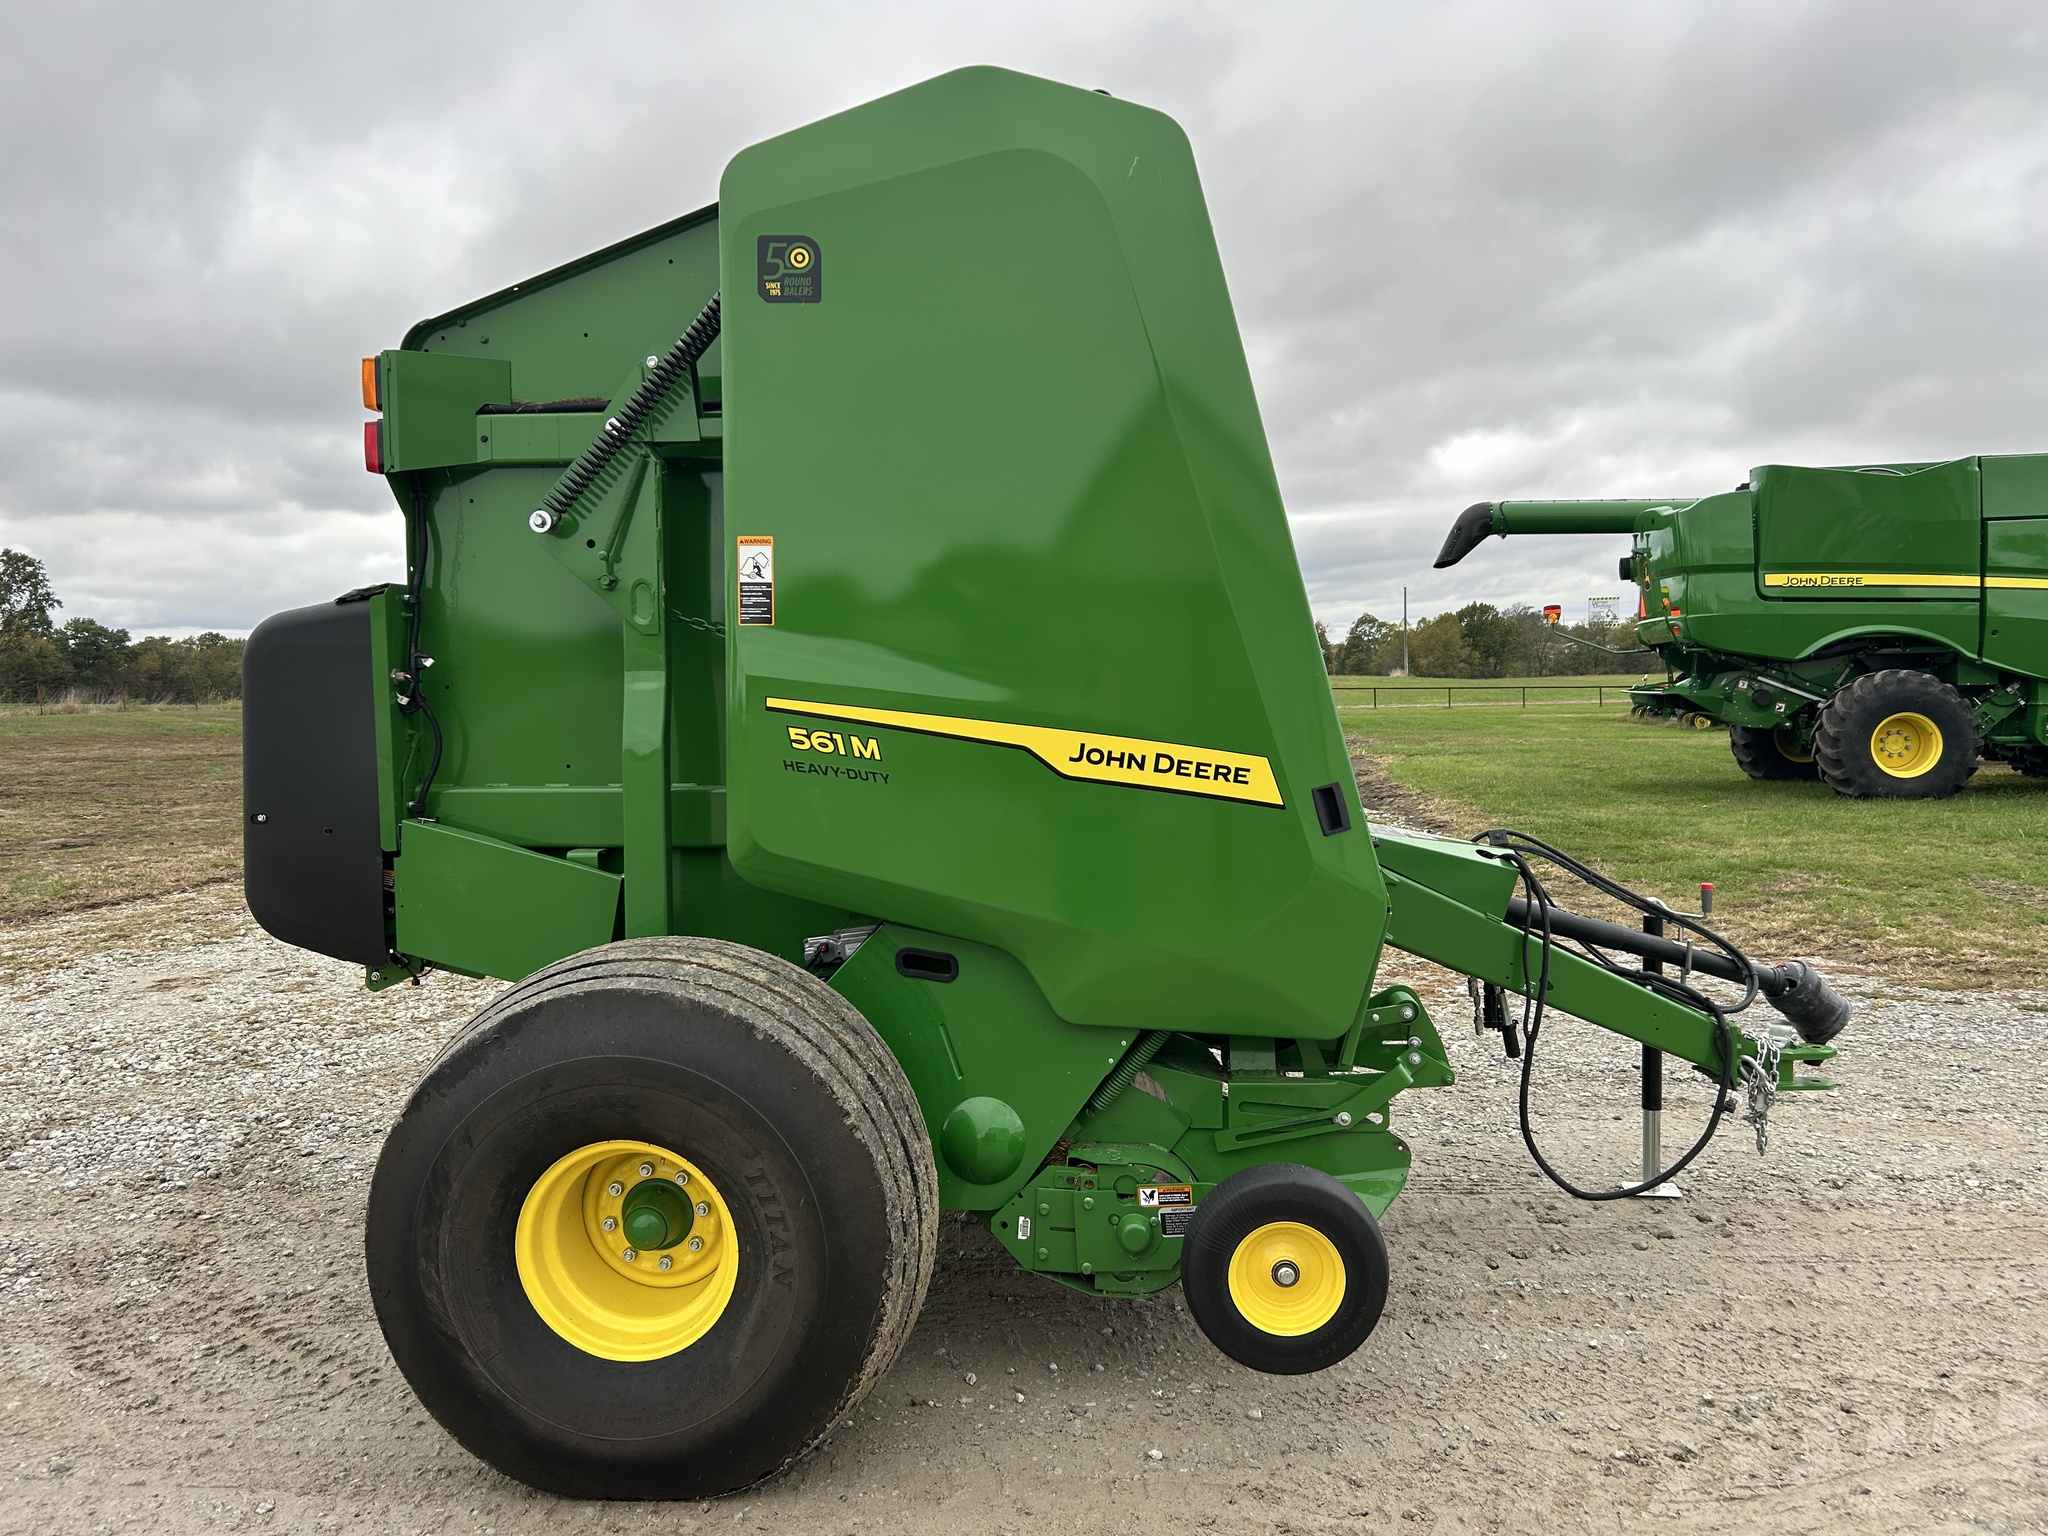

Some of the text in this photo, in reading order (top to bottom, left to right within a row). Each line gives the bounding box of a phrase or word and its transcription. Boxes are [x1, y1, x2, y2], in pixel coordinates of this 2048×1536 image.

[784, 277, 812, 286] ROUND
[784, 287, 813, 296] BALERS
[1782, 576, 1864, 585] JOHN DEERE
[786, 725, 882, 762] 561 M
[783, 760, 890, 784] HEAVY-DUTY
[1069, 743, 1251, 785] JOHN DEERE
[744, 1168, 794, 1293] TITAN
